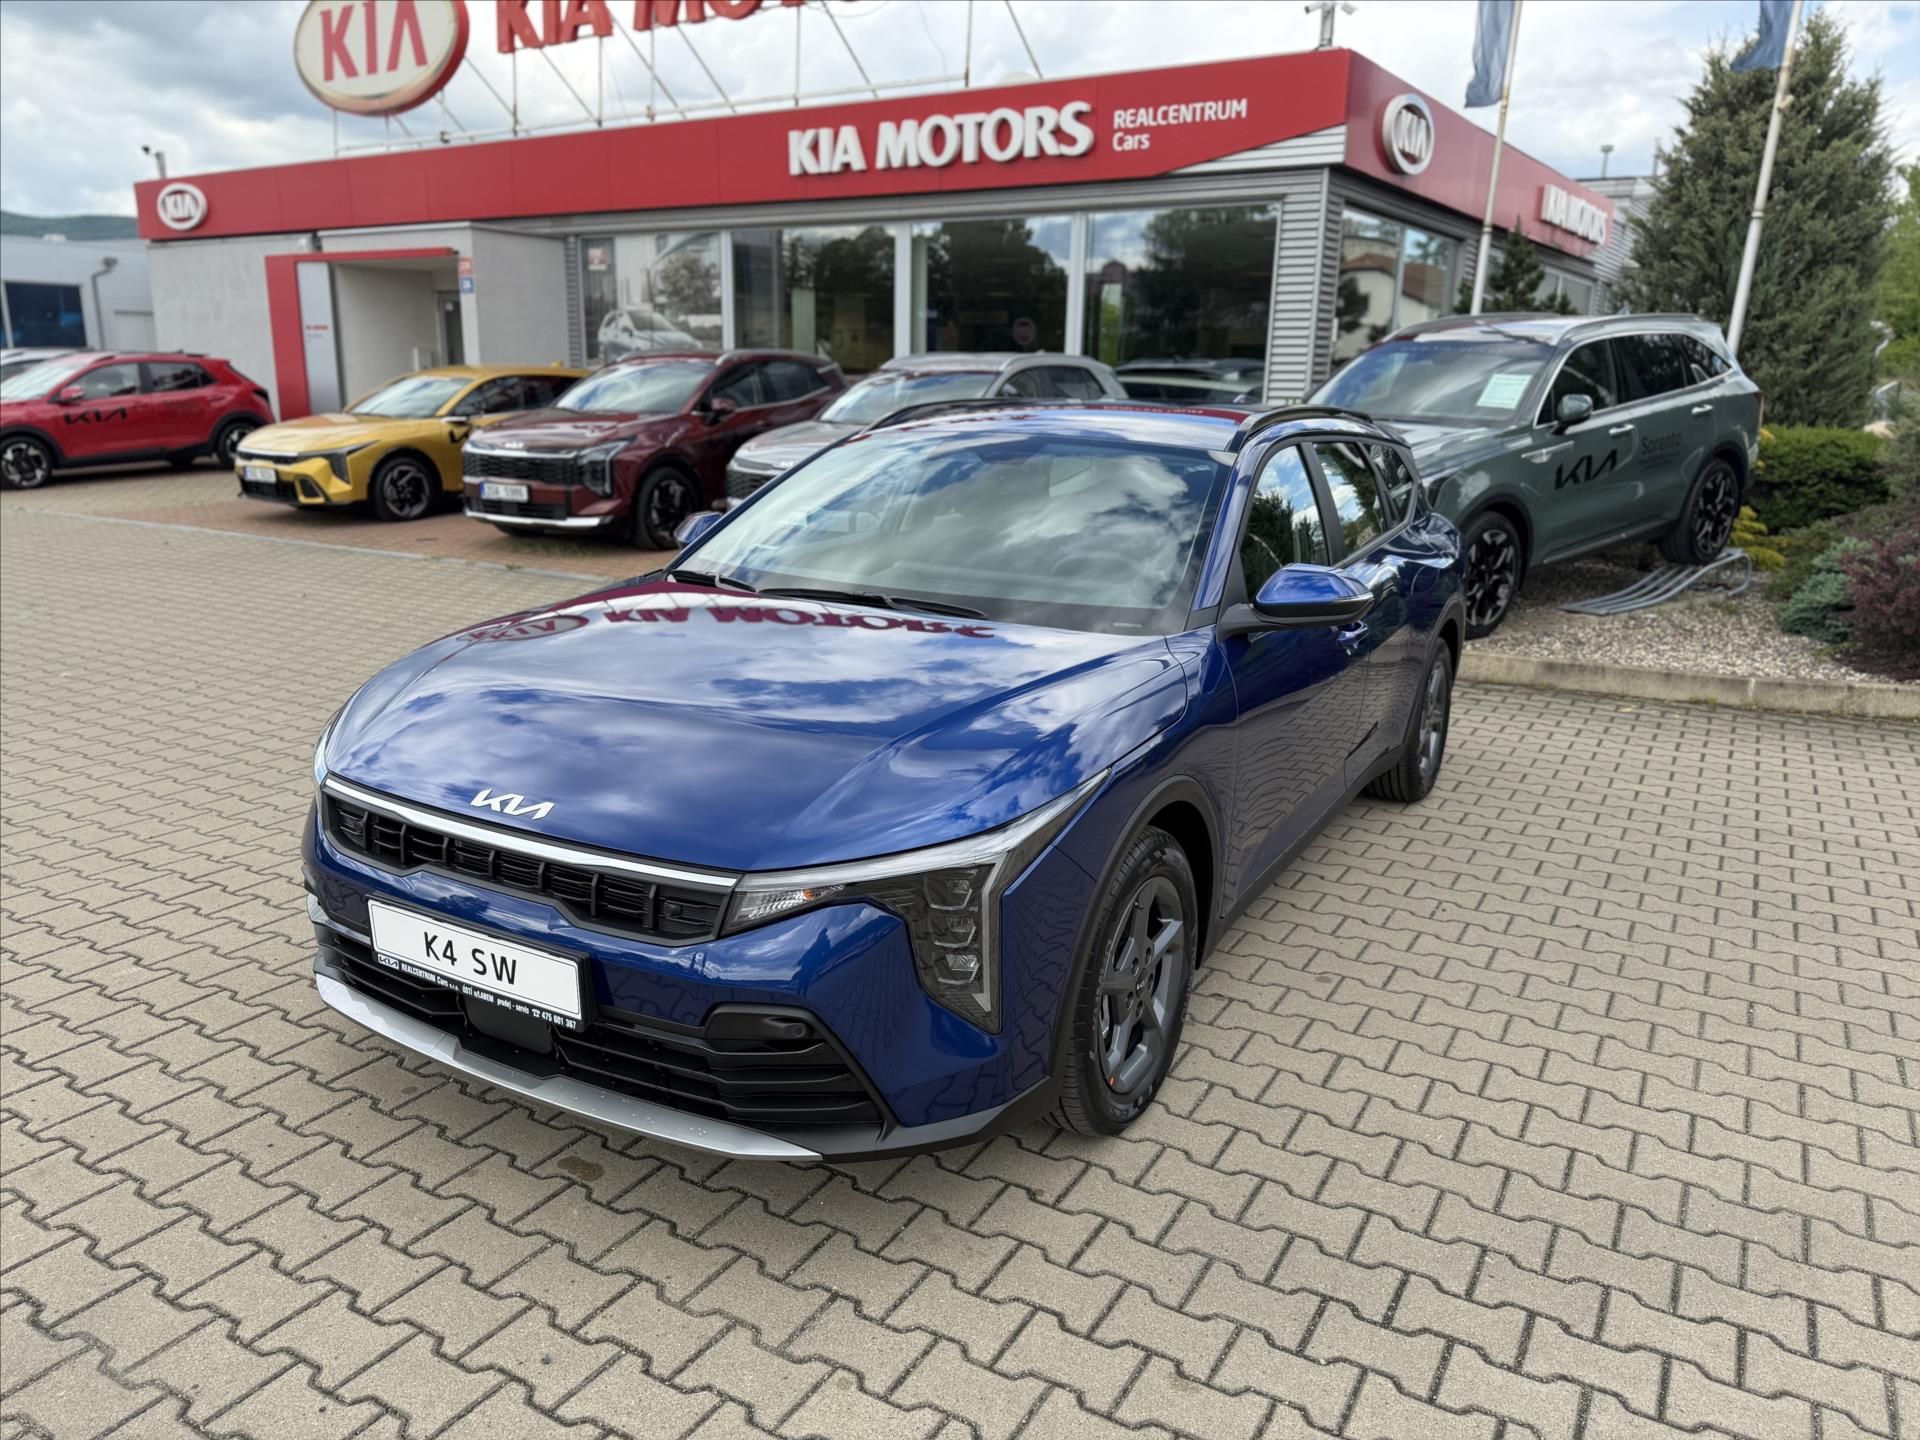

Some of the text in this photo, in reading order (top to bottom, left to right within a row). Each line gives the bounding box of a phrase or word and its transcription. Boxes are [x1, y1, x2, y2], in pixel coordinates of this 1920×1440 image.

[319, 0, 429, 82] KIA
[496, 0, 613, 54] KIA
[1112, 98, 1248, 130] REALCENTRUM
[1396, 108, 1427, 160] KIA
[787, 101, 1095, 176] KIA MOTORS
[1112, 131, 1151, 152] Cars
[164, 193, 198, 219] KIA
[63, 407, 128, 425] KIA
[1553, 448, 1618, 490] KIA
[470, 788, 555, 820] KIA
[379, 955, 399, 969] KIA
[423, 931, 517, 985] K4 SW
[401, 963, 436, 984] REALCENTRUM
[436, 975, 449, 988] Cars
[497, 998, 512, 1011] prodej
[515, 1003, 530, 1014] servis
[541, 1008, 552, 1022] 475
[553, 1012, 564, 1025] 601
[565, 1016, 577, 1030] 367
